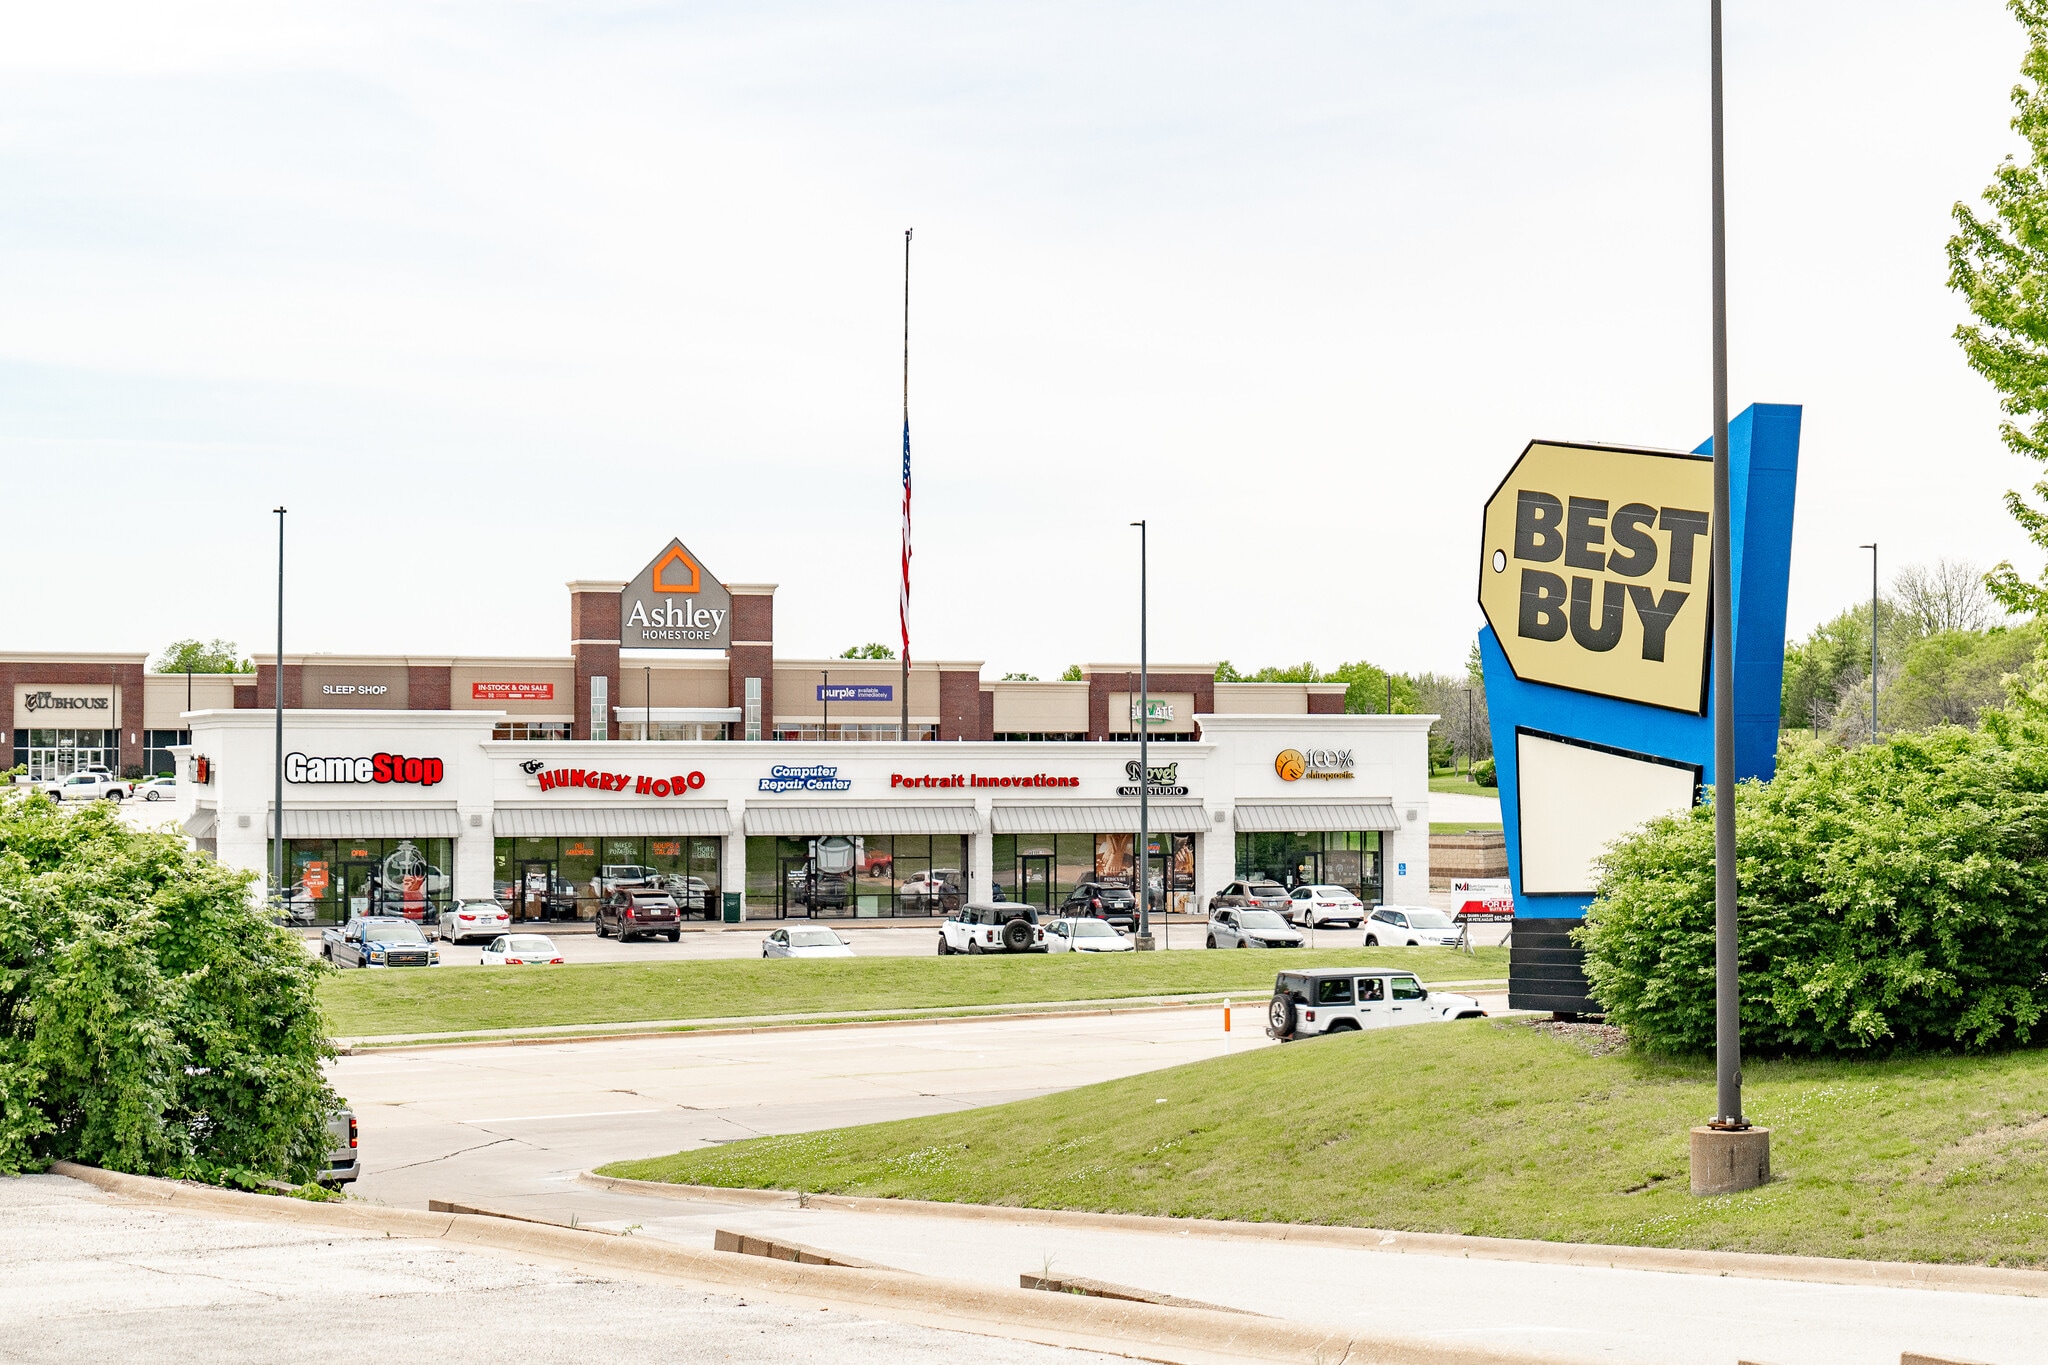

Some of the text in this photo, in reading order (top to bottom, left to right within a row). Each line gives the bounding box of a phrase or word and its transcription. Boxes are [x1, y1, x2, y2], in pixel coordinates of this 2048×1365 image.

[1514, 489, 1709, 584] BEST
[626, 598, 726, 635] Ashley
[1518, 568, 1690, 662] BUY
[642, 630, 710, 640] HOMESTORE
[322, 685, 387, 695] SLEEP SHOP
[821, 687, 856, 699] purple
[25, 694, 109, 712] CLUBHOUSE
[1132, 705, 1174, 718] ELVATE
[1306, 749, 1354, 768] 100%
[285, 752, 443, 786] GameStop
[519, 759, 545, 774] The
[773, 766, 836, 778] Computer
[537, 769, 705, 797] HUNGRY HOBO
[760, 779, 850, 792] Repair Center
[891, 773, 1080, 788] Portrait Innovations
[1147, 787, 1184, 795] STUDIO
[1455, 882, 1469, 891] NAI
